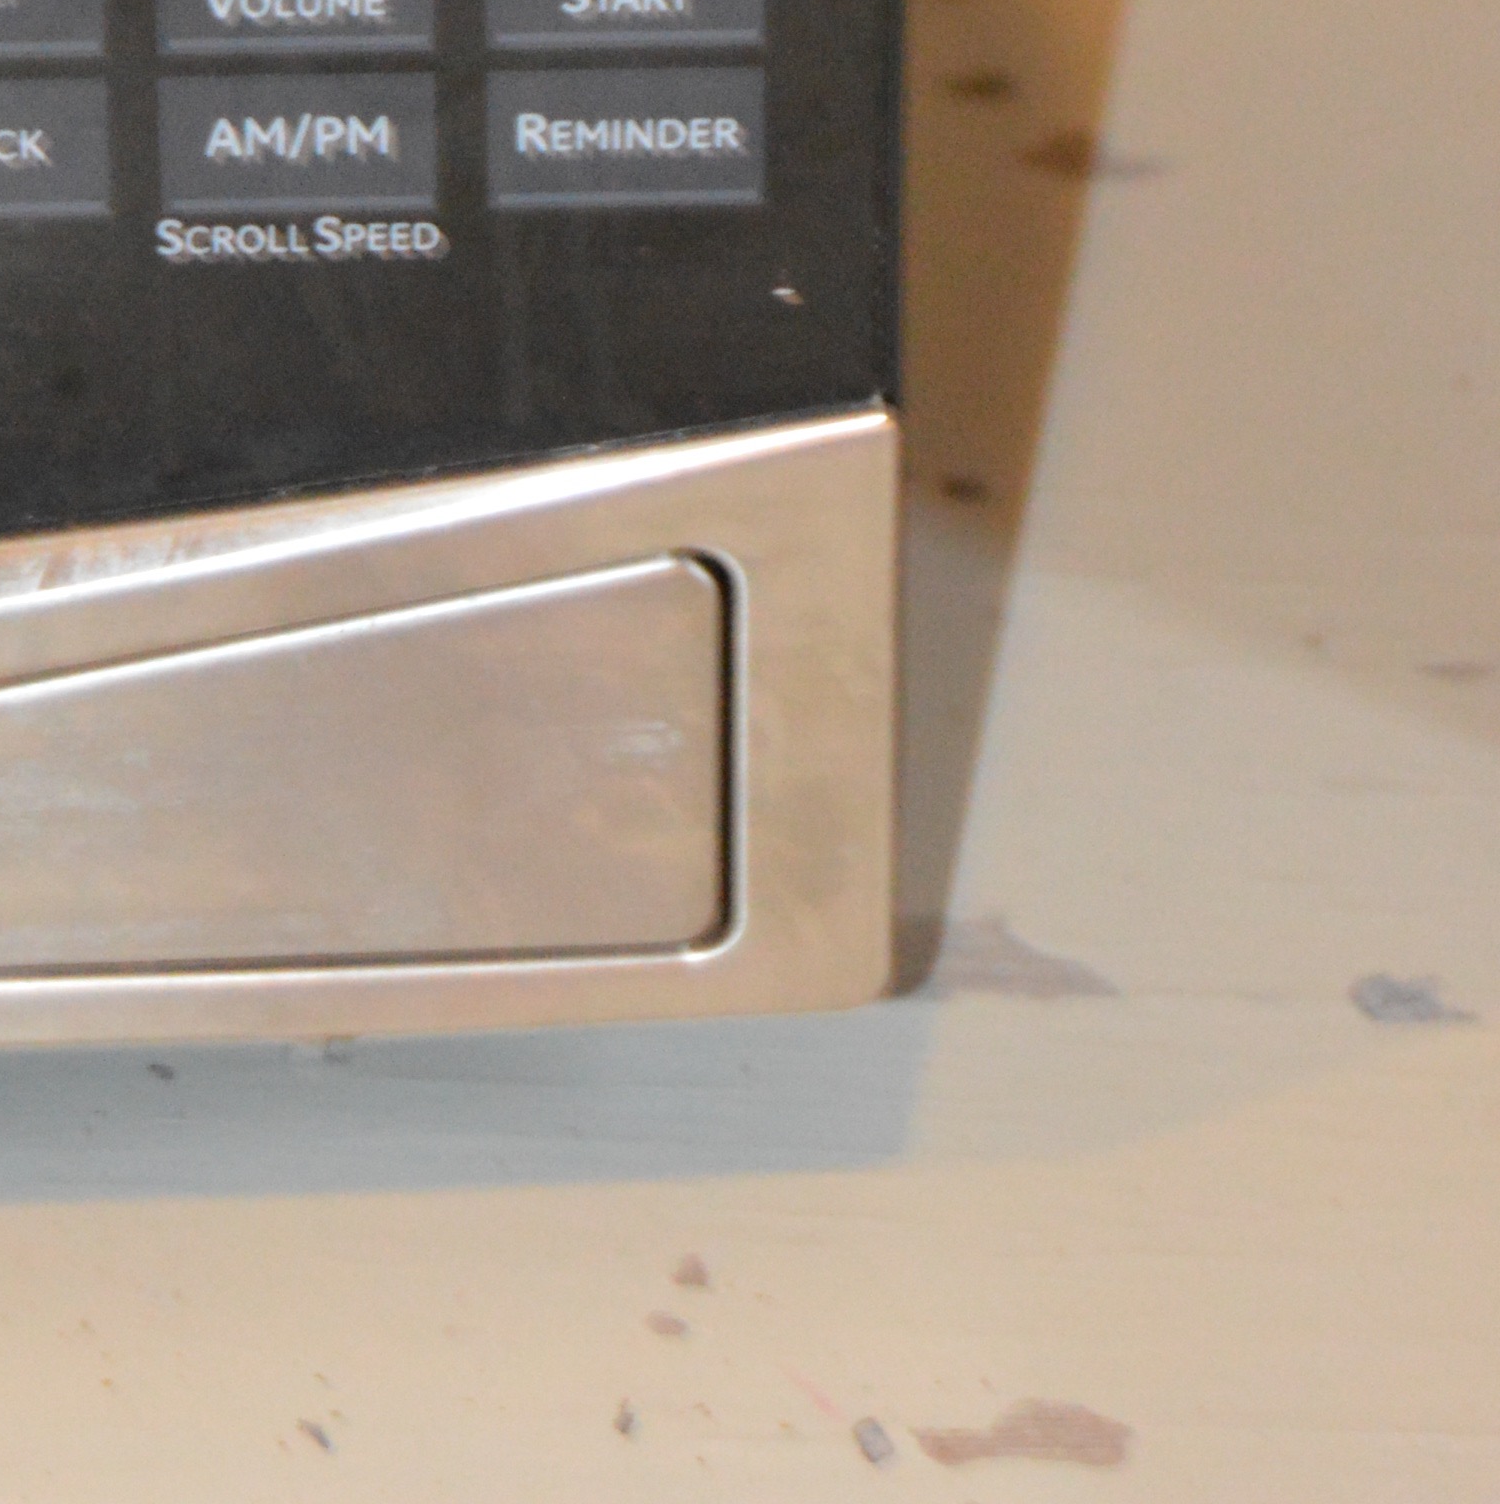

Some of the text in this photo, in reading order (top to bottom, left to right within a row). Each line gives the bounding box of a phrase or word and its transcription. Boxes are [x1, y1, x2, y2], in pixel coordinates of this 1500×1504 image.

[205, 114, 390, 159] AM/PM
[516, 113, 739, 153] REMINDER
[156, 216, 440, 258] SCROLL SPEED
